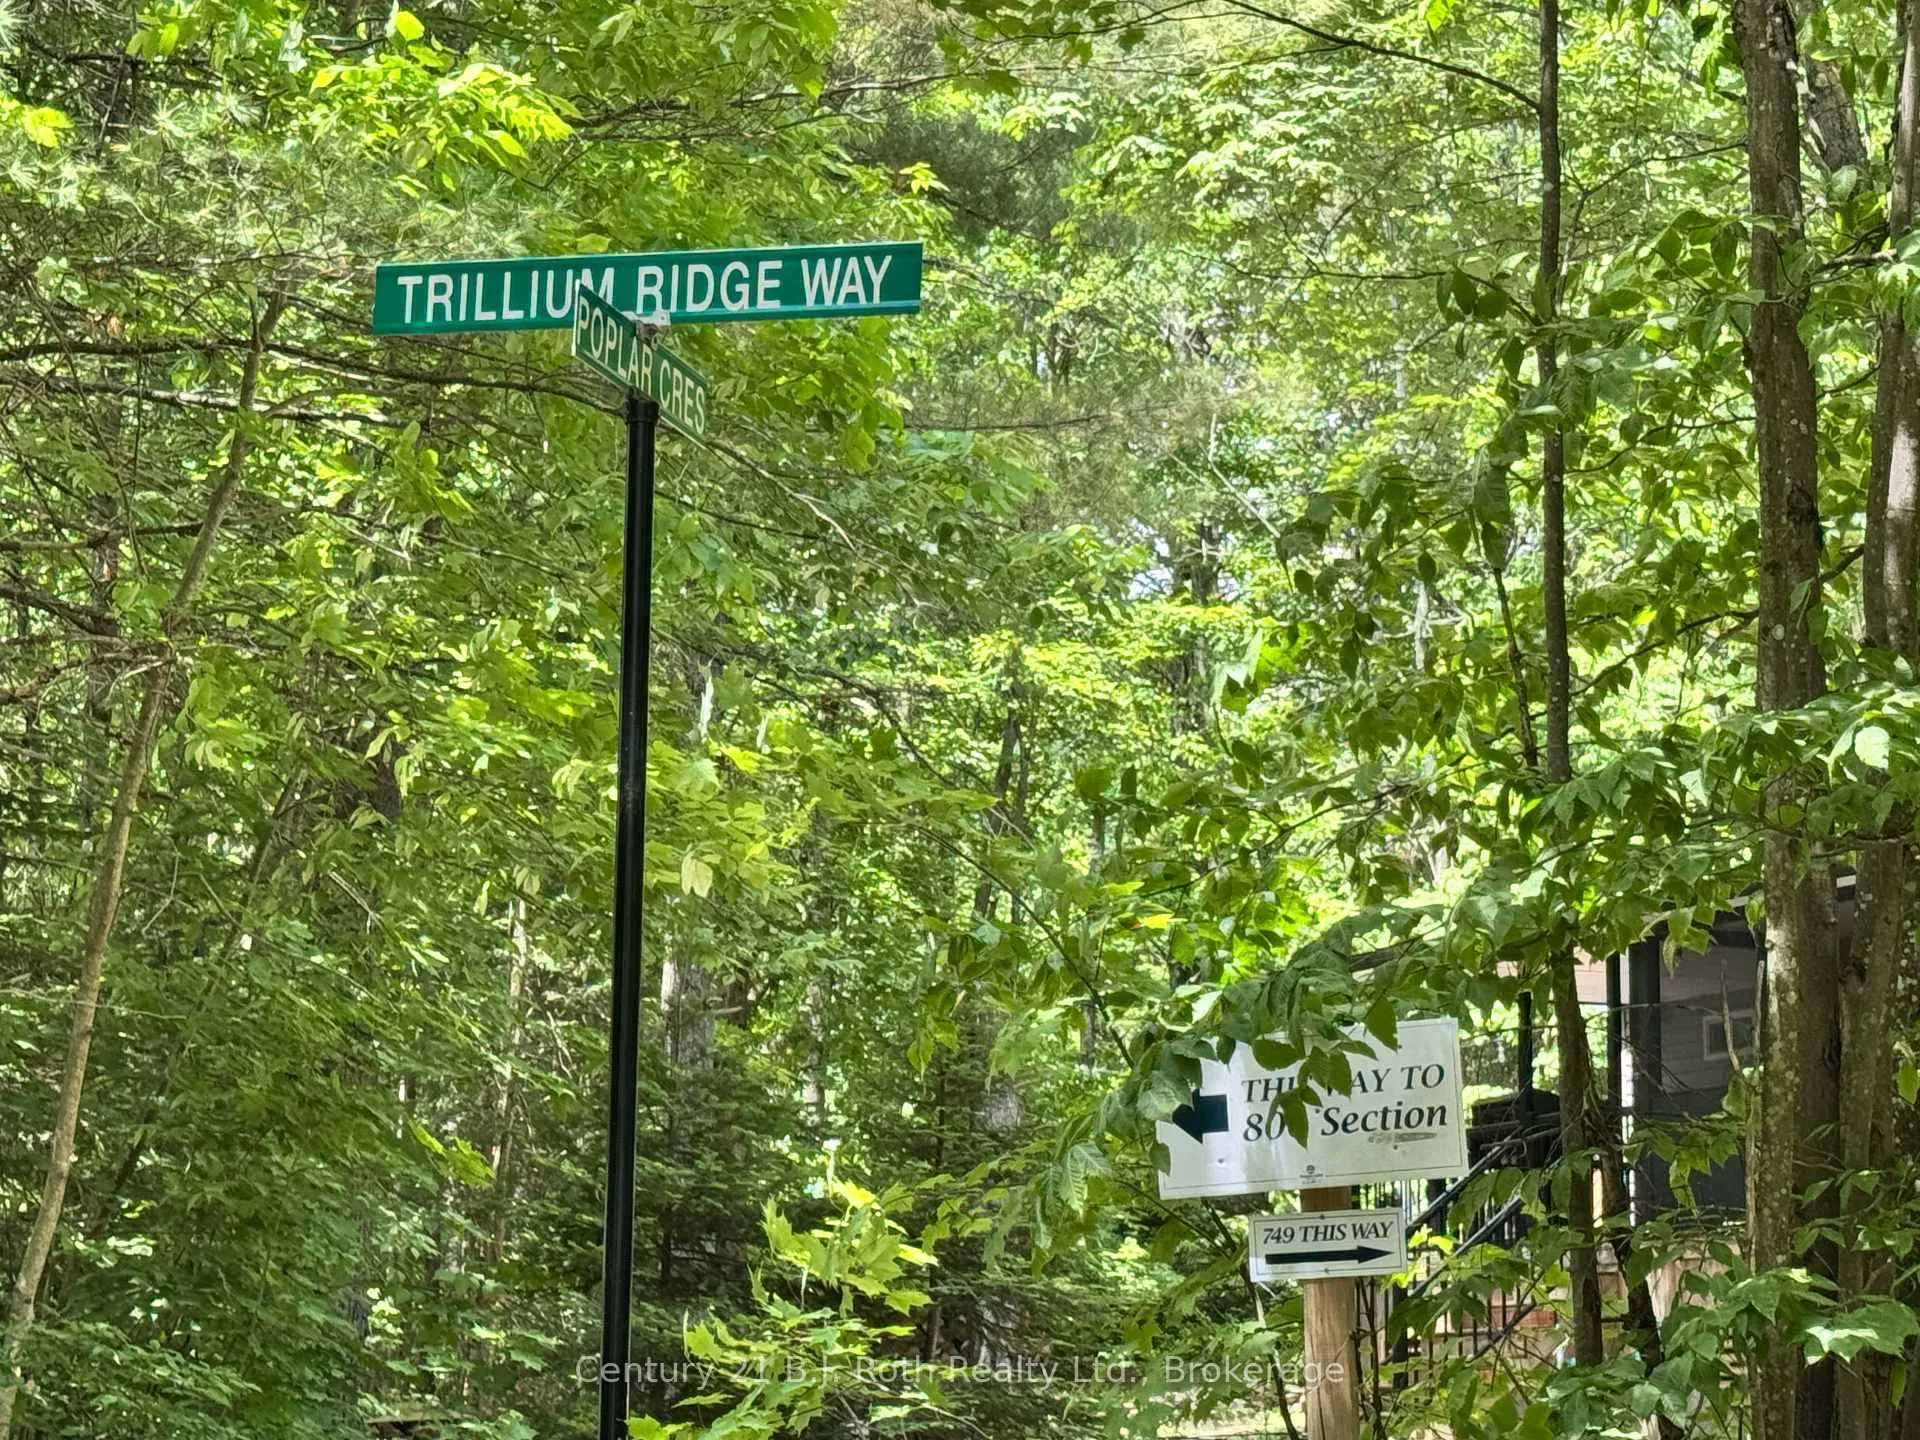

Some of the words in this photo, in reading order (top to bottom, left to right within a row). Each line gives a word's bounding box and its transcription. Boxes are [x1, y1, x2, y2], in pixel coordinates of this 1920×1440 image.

[397, 267, 614, 324] TRILLIUM
[636, 259, 784, 315] RIDGE
[801, 254, 893, 307] WAY
[576, 296, 654, 397] POPLAR
[659, 359, 706, 435] CRES
[1318, 1067, 1391, 1095] AY
[1401, 1063, 1445, 1090] TO
[1320, 1101, 1448, 1137] Section
[1263, 1226, 1295, 1245] 749
[1299, 1223, 1347, 1242] THIS
[1351, 1220, 1394, 1240] WAY
